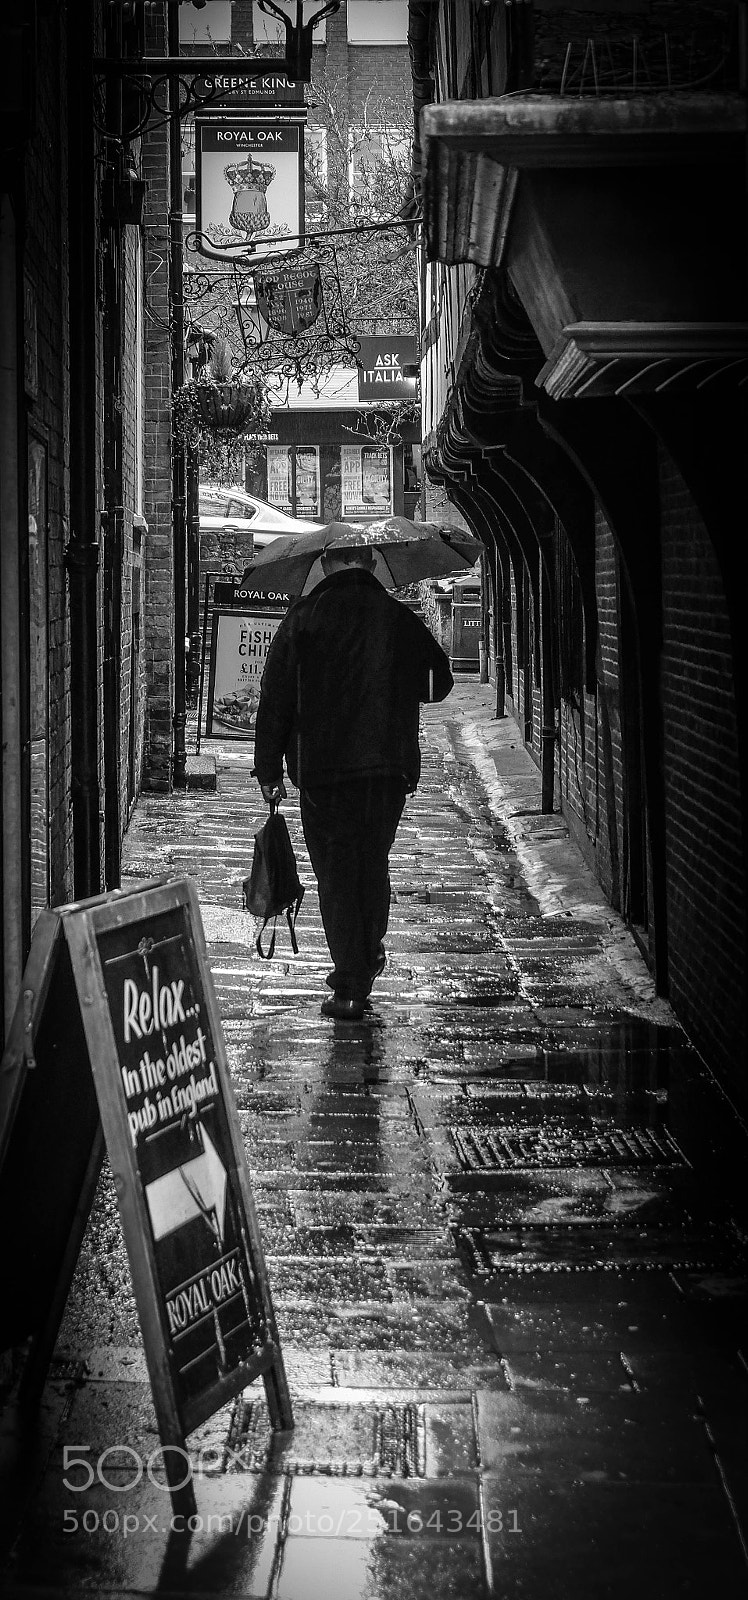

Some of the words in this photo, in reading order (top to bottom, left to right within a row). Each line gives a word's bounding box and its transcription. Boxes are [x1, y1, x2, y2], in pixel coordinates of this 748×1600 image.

[204, 77, 257, 88] GREENE
[262, 77, 296, 88] KING
[217, 131, 254, 141] ROYAL
[257, 131, 283, 141] OAK
[283, 270, 316, 281] BEGOT
[274, 280, 304, 290] OUSE
[375, 353, 400, 366] ASK
[363, 370, 407, 383] ITALIA
[344, 460, 361, 473] APP
[270, 481, 287, 491] FREE
[344, 480, 361, 490] FREE
[344, 491, 362, 501] NOW!
[234, 589, 265, 599] ROYAL
[267, 591, 290, 601] OAK
[240, 630, 272, 644] FISH
[124, 965, 201, 1044] Relax...
[121, 1065, 142, 1099] In
[139, 1050, 167, 1092] the
[166, 1027, 207, 1081] oldest
[127, 1096, 158, 1149] pub
[156, 1090, 174, 1122] in
[170, 1061, 220, 1119] England
[166, 1278, 213, 1334] ROYAL
[211, 1258, 241, 1302] OAK
